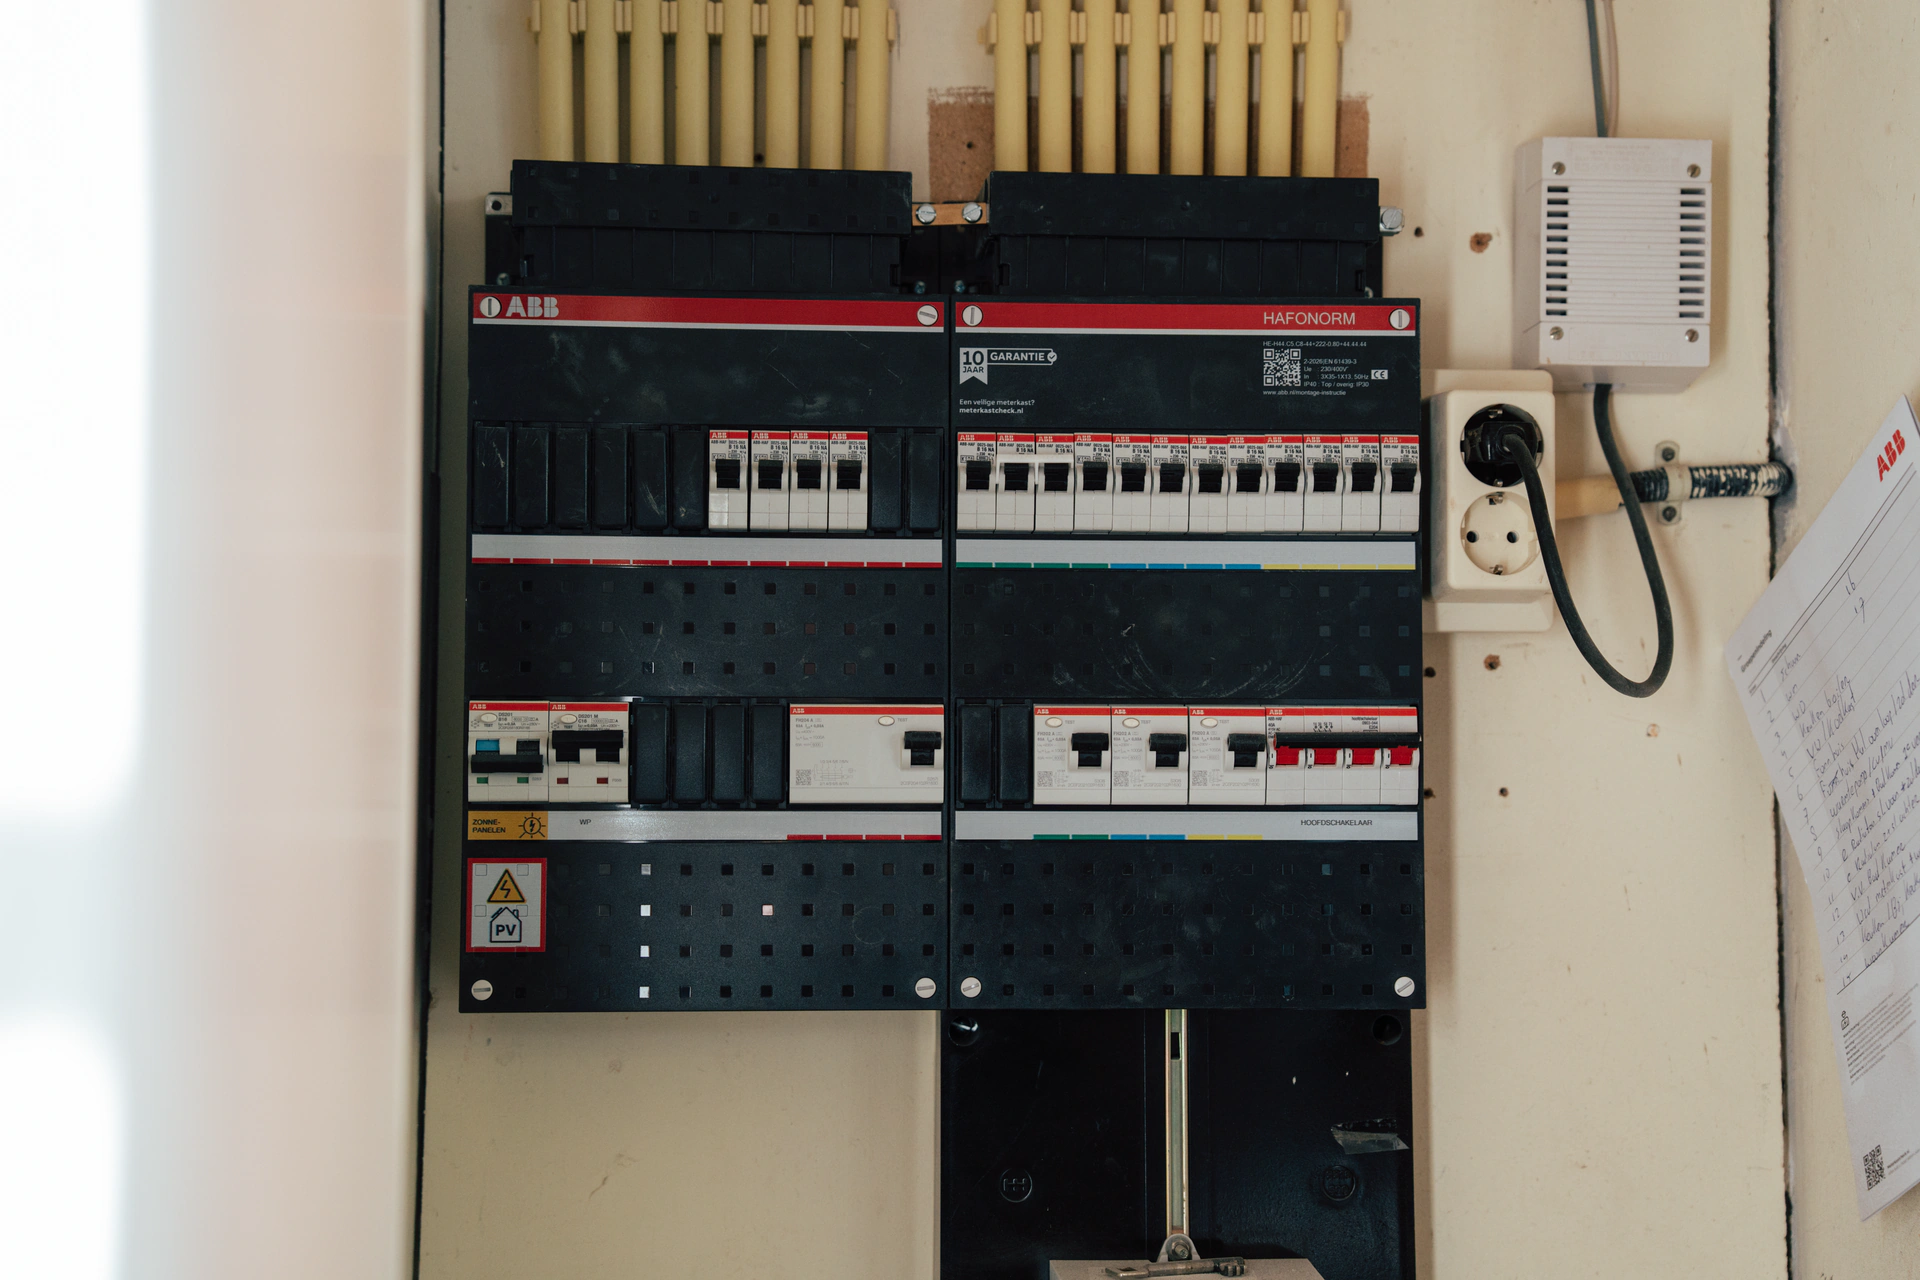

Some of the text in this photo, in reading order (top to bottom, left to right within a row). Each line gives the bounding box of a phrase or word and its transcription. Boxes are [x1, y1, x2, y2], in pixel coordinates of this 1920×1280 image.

[505, 296, 559, 318] ABB
[1263, 311, 1356, 325] HAFONORM
[962, 350, 985, 366] 10
[990, 352, 1045, 361] GARANTIE
[1876, 429, 1906, 482] ABB
[472, 826, 506, 834] PANELEN
[495, 924, 517, 936] PV
